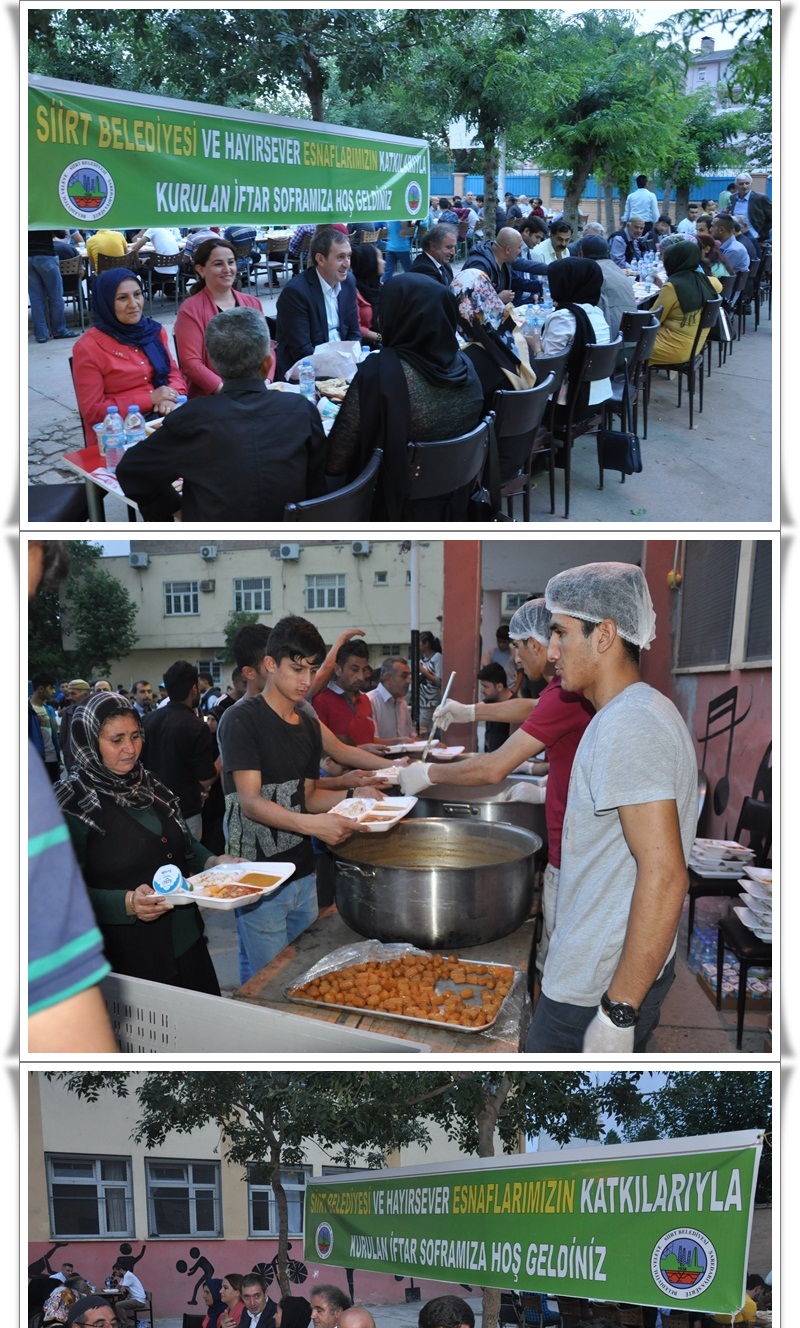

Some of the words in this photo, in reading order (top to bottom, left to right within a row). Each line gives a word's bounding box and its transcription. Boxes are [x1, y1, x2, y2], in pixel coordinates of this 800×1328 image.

[36, 98, 93, 146] SİİRT
[98, 115, 197, 157] BELEDİYESİ
[202, 128, 221, 159] VE
[225, 131, 301, 165] HAYIRSEVER
[303, 141, 378, 171] ESNAFLARIMIZIN
[379, 150, 427, 174] KATKILARIYLA
[156, 181, 231, 213] KURULAN
[234, 179, 270, 213] İFTAR
[273, 186, 333, 213] SOFRAMIZA
[336, 189, 354, 217] HOŞ
[356, 185, 393, 211] GELDİNİZ
[328, 1186, 371, 1215] BELEDİYESİ
[373, 1190, 385, 1215] VE
[387, 1186, 450, 1215] HAYIRSEVER
[452, 1179, 576, 1215] ESNAFLARIMIZIN
[580, 1168, 743, 1213] KATKILARIYLA
[350, 1235, 389, 1261] KURULAN
[390, 1231, 418, 1265] İFTAR
[419, 1238, 487, 1271] SOFRAMIZA
[491, 1241, 522, 1283] HOŞ
[525, 1236, 607, 1282] GELDİNİZ
